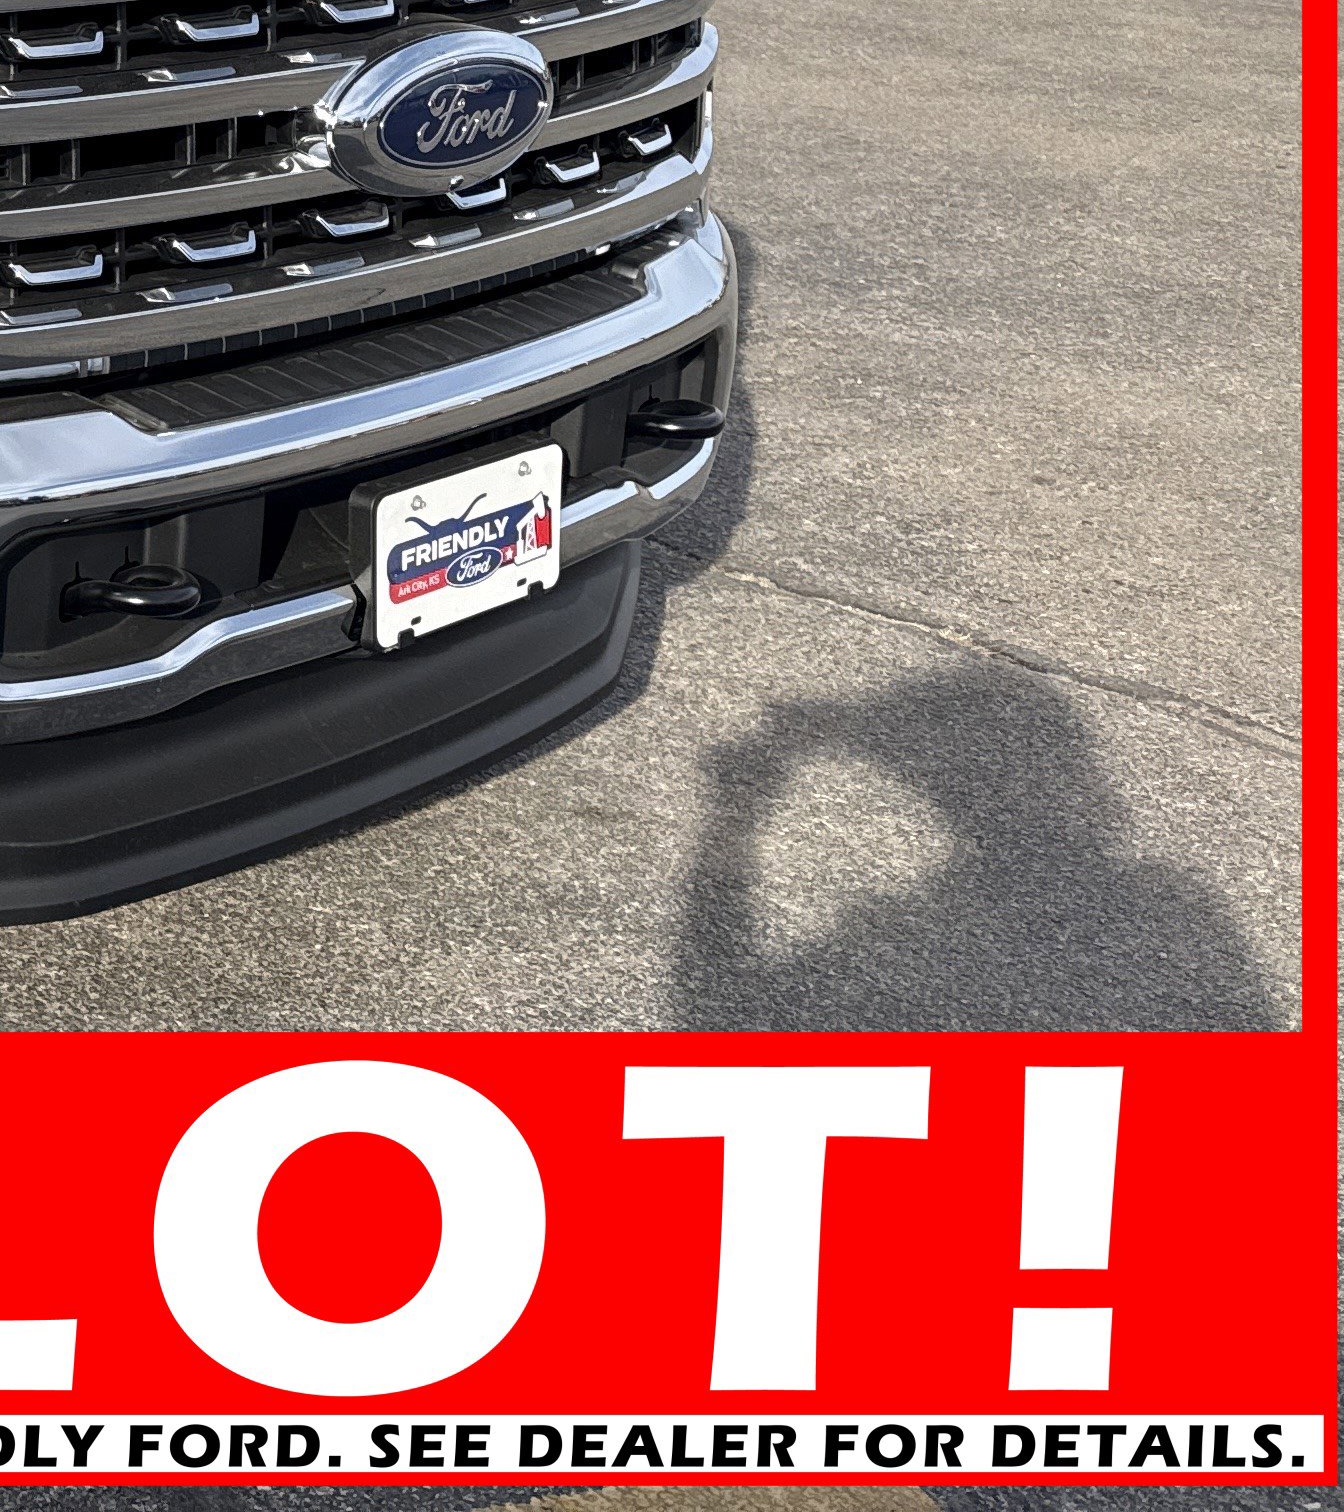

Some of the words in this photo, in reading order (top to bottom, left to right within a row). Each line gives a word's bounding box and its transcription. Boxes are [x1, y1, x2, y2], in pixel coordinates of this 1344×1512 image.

[416, 79, 518, 154] Ford
[401, 515, 509, 571] FRIENDLY
[456, 551, 492, 582] Ford
